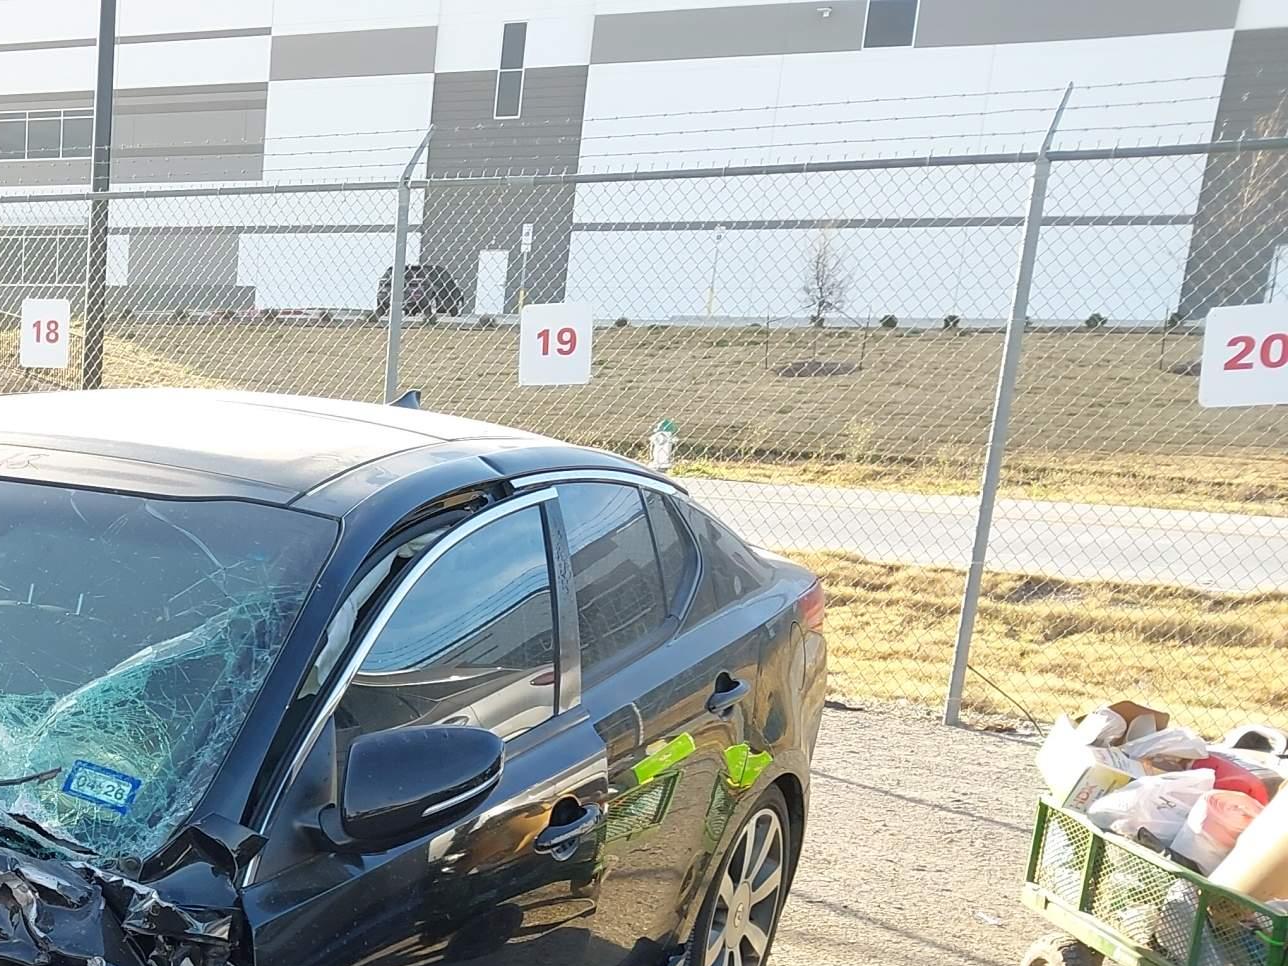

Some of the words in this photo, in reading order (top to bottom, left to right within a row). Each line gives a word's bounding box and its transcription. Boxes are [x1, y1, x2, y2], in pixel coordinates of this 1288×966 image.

[32, 319, 60, 344] 18
[536, 327, 577, 356] 19
[1223, 332, 1288, 371] 20
[103, 784, 125, 800] 26
